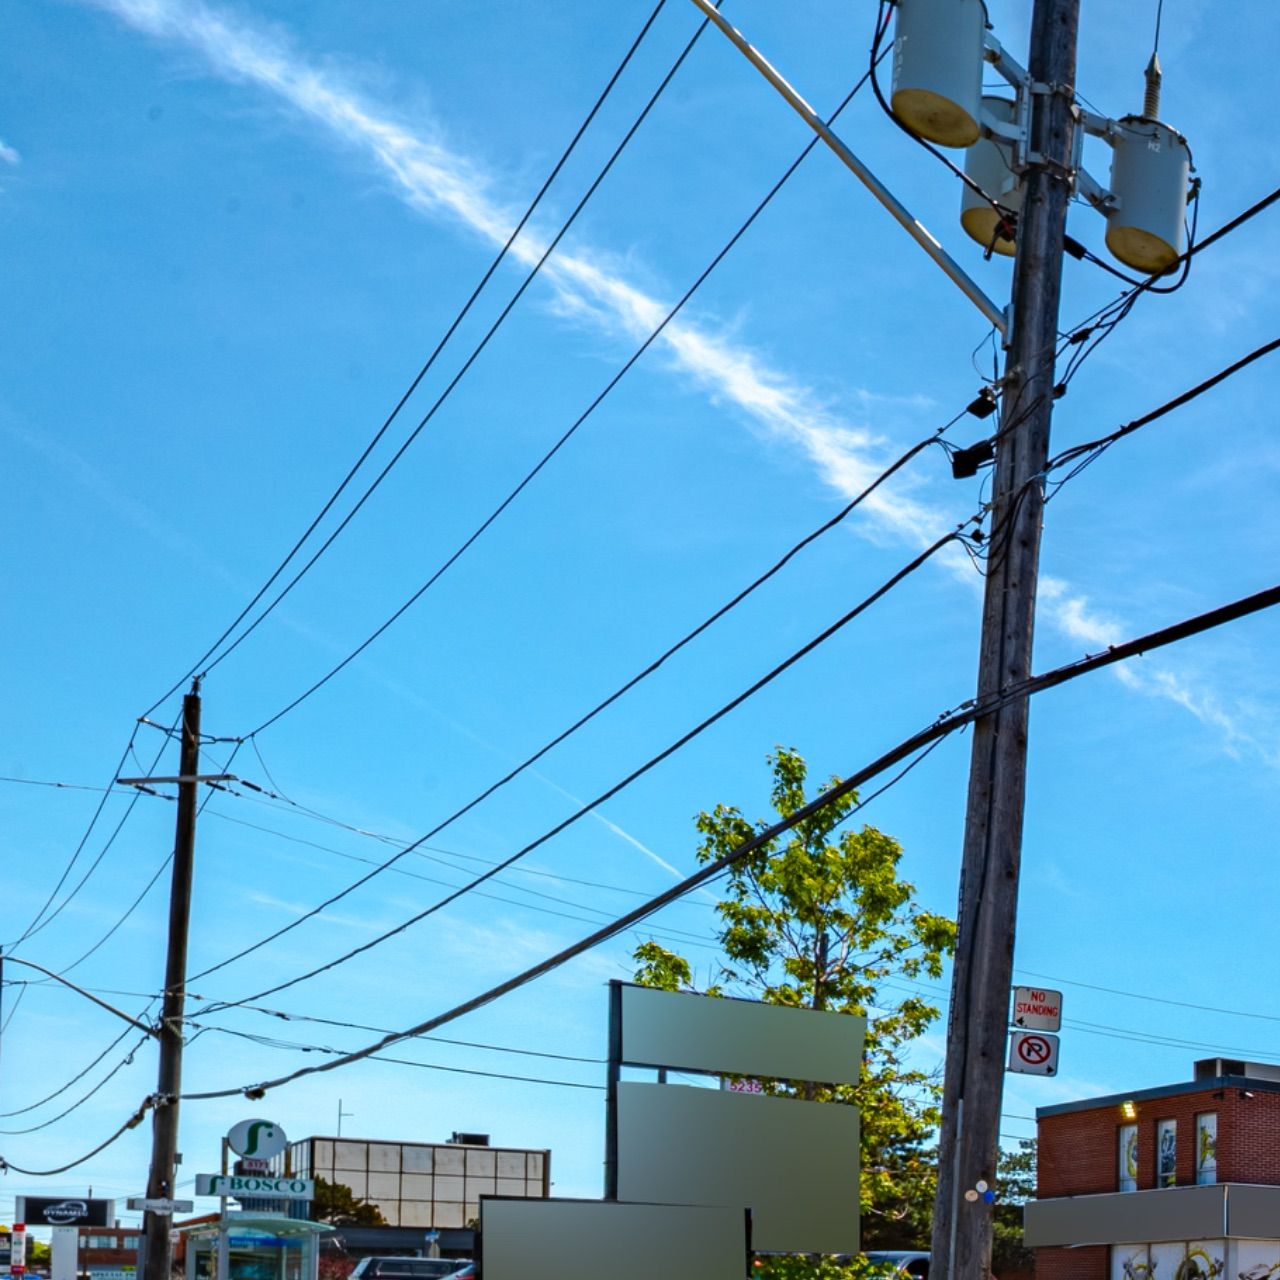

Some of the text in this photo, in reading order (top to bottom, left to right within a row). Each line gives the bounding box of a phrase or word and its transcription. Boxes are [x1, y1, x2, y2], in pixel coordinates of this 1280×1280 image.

[1031, 991, 1045, 1002] NO
[1016, 1003, 1058, 1017] STANDING
[230, 1177, 306, 1193] BOSCO
